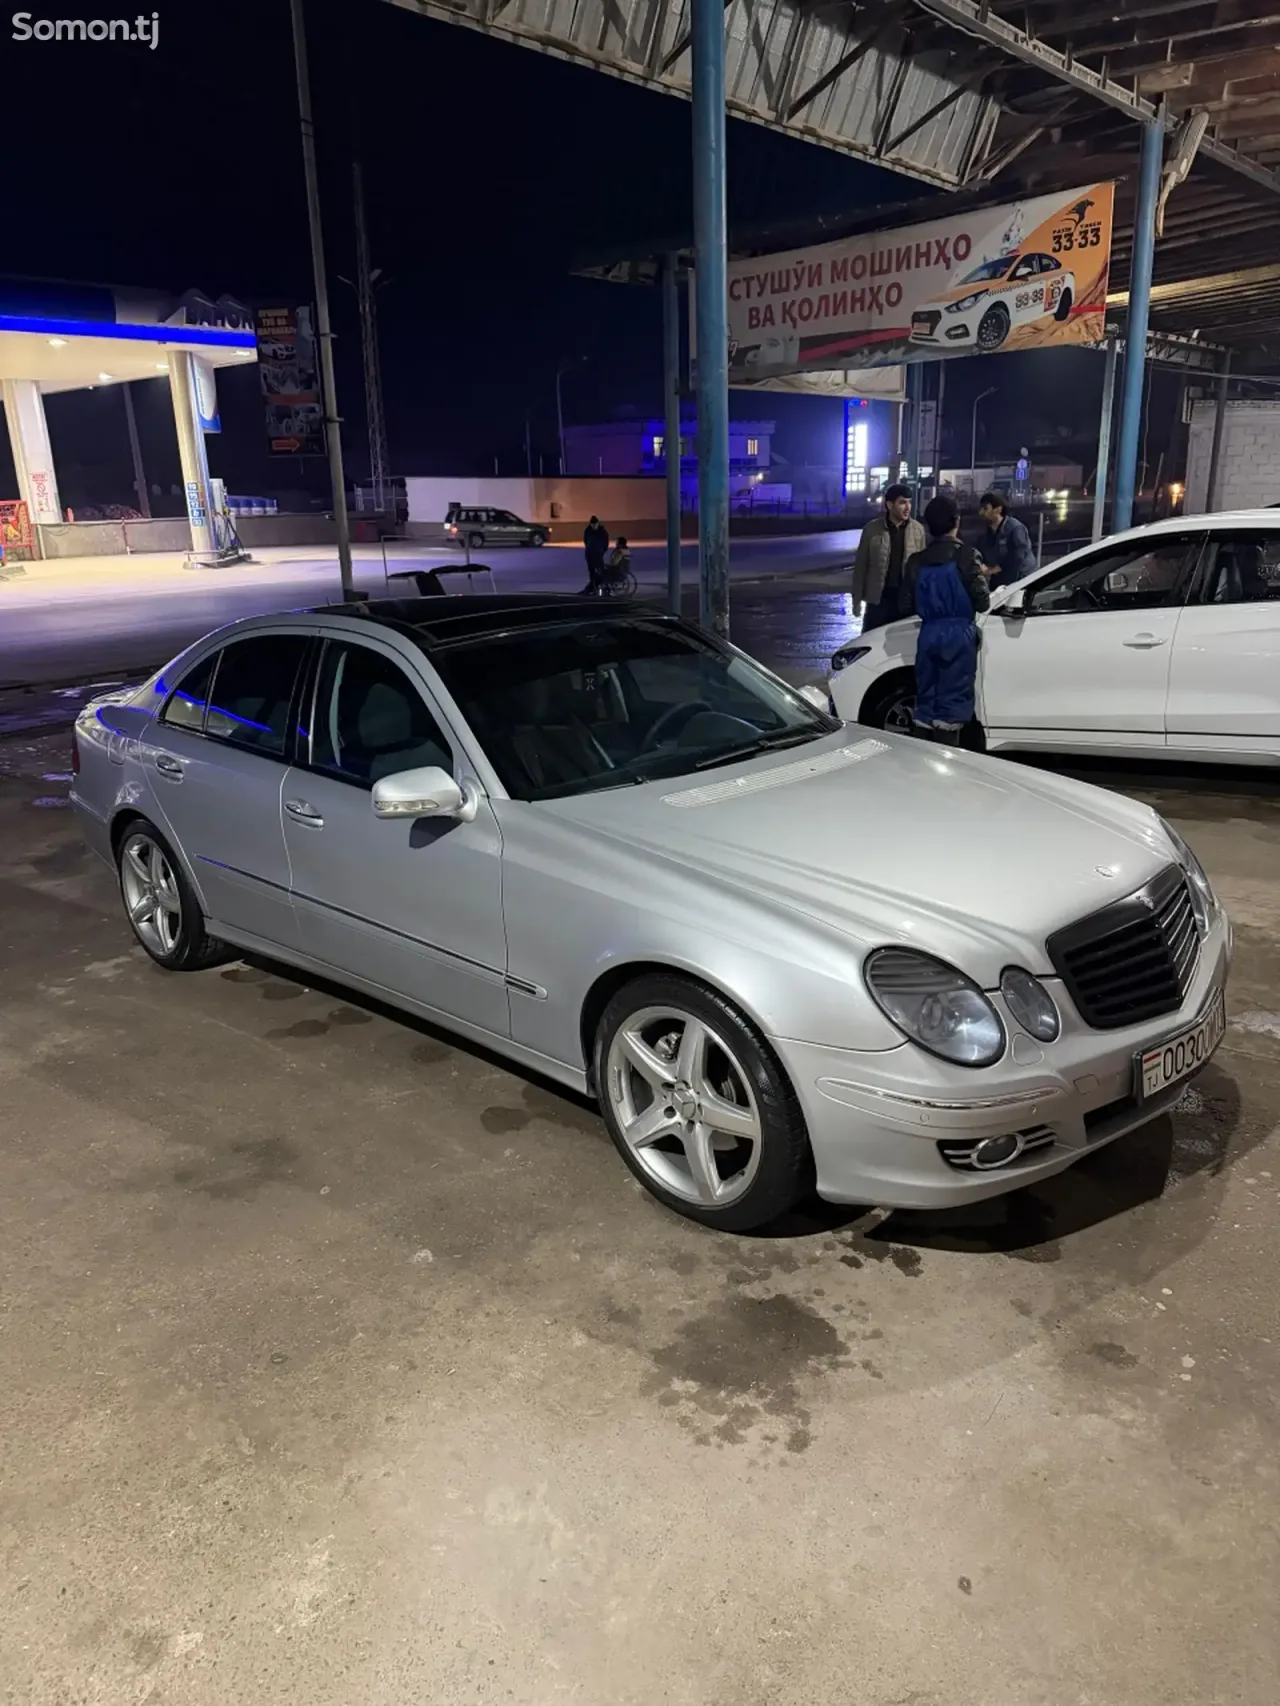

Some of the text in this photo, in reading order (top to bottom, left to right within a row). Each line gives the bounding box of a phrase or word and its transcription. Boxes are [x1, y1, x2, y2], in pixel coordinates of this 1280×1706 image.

[729, 233, 971, 301] СТУШӮИ МОШИНҲО
[748, 282, 903, 330] ВА ҚОЛИНҲО
[1147, 1073, 1158, 1091] TJ
